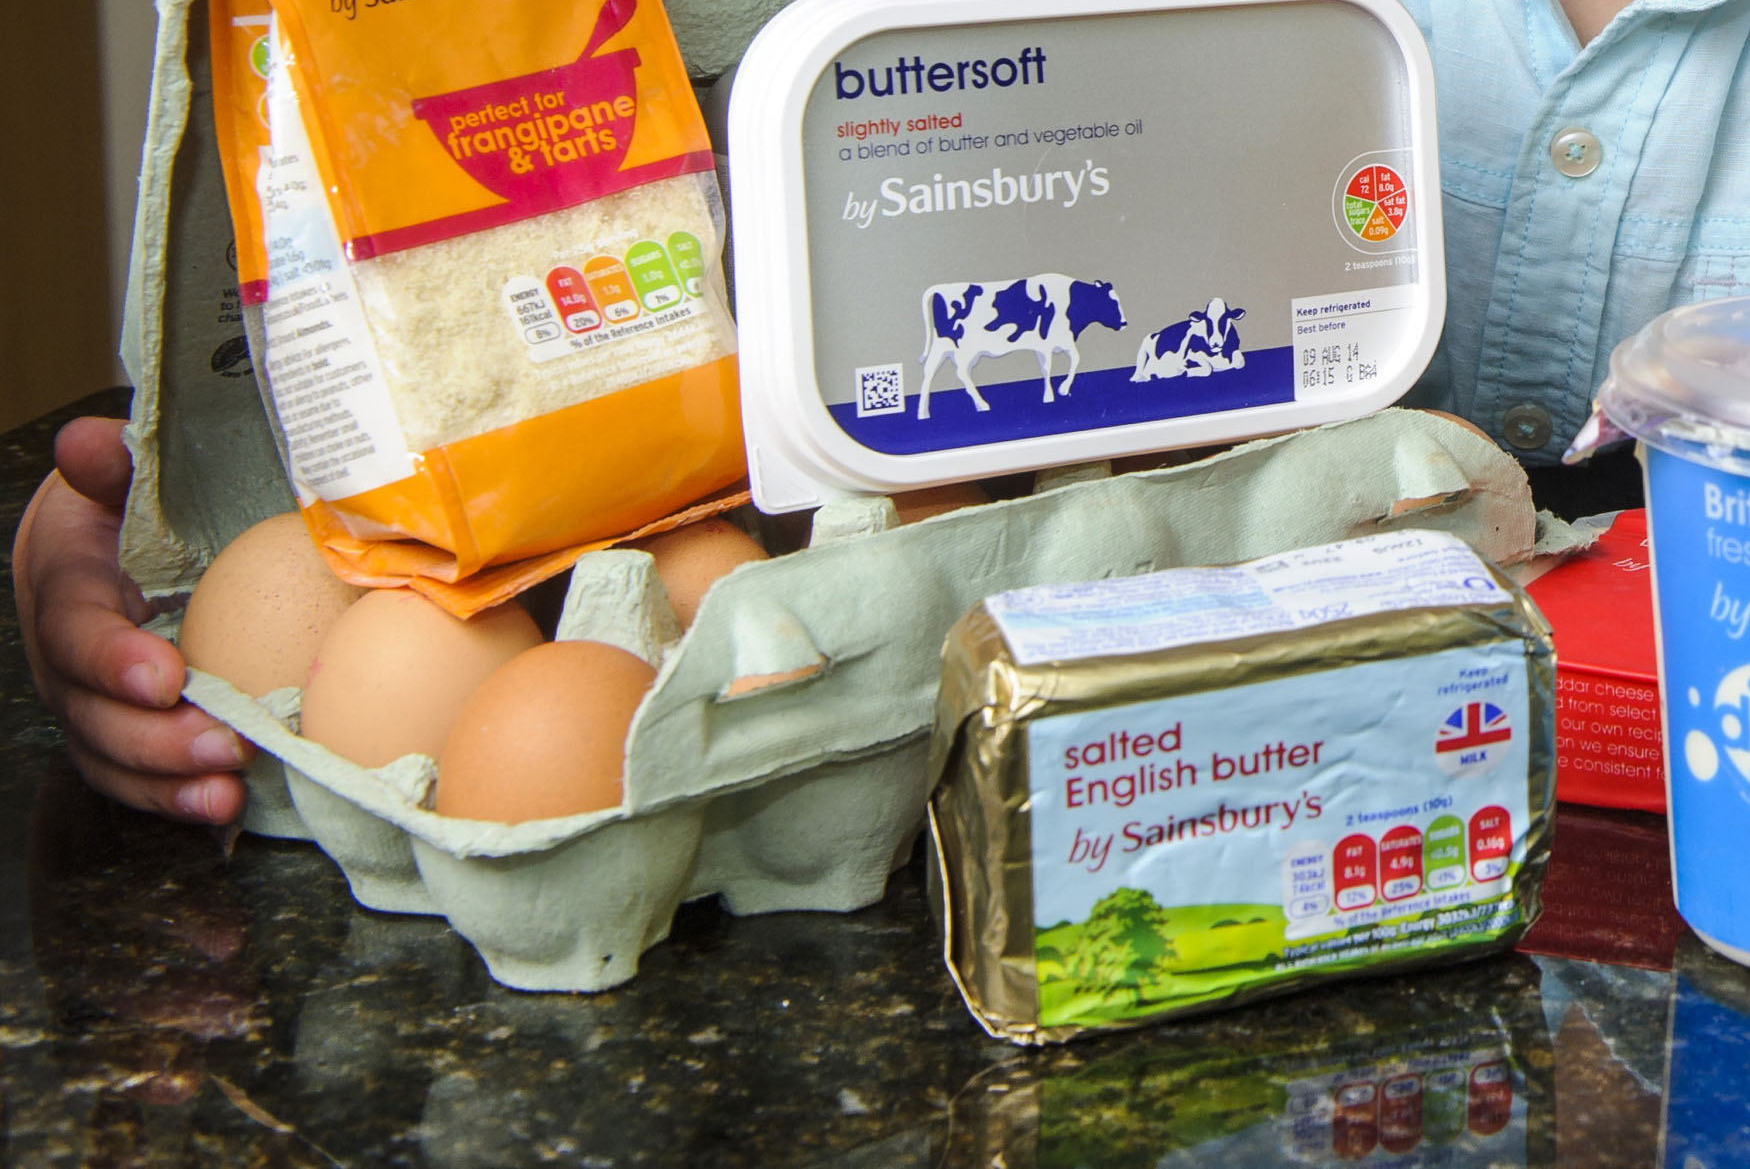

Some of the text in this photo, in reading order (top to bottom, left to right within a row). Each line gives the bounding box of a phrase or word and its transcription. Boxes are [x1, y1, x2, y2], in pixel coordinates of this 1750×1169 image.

[834, 47, 1046, 100] buttersoft
[450, 91, 564, 133] perfect for
[448, 94, 635, 160] frangipane
[837, 113, 962, 140] slightly salted
[839, 119, 1143, 161] a blend of butter and vegetable oil
[510, 127, 617, 174] & tarts
[1360, 175, 1369, 183] cal
[1381, 173, 1391, 181] fat
[842, 159, 1110, 228] by Sainsbury's
[1379, 183, 1394, 192] 8.0g
[1349, 207, 1370, 216] sugars
[630, 250, 662, 267] SUGARS
[1345, 259, 1393, 270] 2 teaspoons
[557, 277, 572, 287] FAT
[510, 288, 538, 303] ENERGY
[656, 293, 669, 303] 1%
[517, 300, 545, 314] 667kJ
[615, 307, 629, 316] 6%
[1297, 300, 1370, 316] Keep refrigerated
[571, 308, 691, 348] % of the Reference Intakes
[573, 316, 594, 328] 20%
[1297, 322, 1345, 334] Best before
[1303, 342, 1358, 366] 09 AUG 14
[1460, 668, 1489, 677] Keep
[1437, 673, 1508, 695] refrigerated
[1596, 682, 1653, 701] cheese
[1568, 699, 1604, 715] from
[1610, 703, 1656, 720] select
[1561, 718, 1585, 731] our
[1592, 721, 1623, 735] own
[1065, 722, 1181, 770] salted
[1580, 741, 1602, 754] we
[1608, 744, 1659, 760] ensure
[1460, 751, 1486, 765] MILK
[1066, 741, 1324, 808] English butter
[1574, 757, 1651, 778] consistent
[1346, 796, 1453, 826] 2 teaspoons (10g)
[1068, 790, 1322, 872] by Sainsbury's
[1479, 818, 1499, 829] SALT
[1381, 836, 1421, 851] SATURATES
[1477, 837, 1505, 850] 0.16g
[1346, 846, 1362, 857] FAT
[1291, 855, 1323, 866] ENERGY
[1390, 856, 1413, 869] 4.9g
[1485, 864, 1501, 875] 3%
[1391, 882, 1412, 894] 25%
[1346, 891, 1367, 903] 12%
[1334, 891, 1470, 927] % of the Reference Intakes
